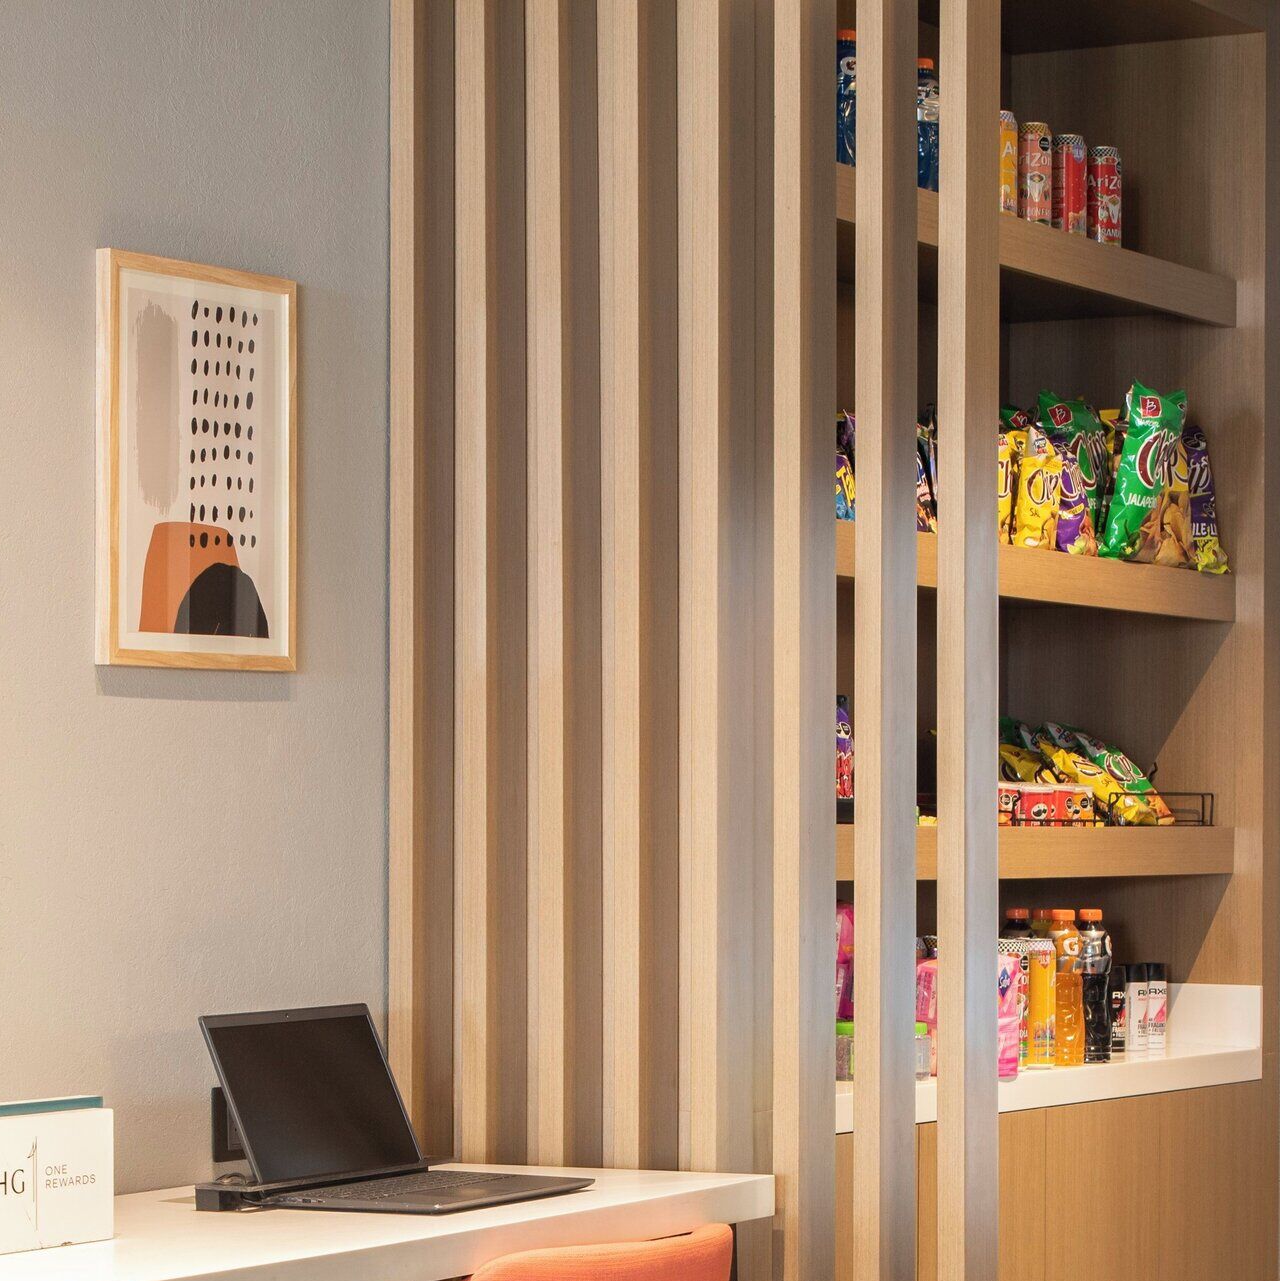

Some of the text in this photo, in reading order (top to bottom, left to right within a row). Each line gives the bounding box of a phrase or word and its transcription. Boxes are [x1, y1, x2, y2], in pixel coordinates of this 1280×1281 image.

[1062, 936, 1080, 956] G
[45, 1164, 68, 1176] ONE
[45, 1173, 96, 1190] REWARDS
